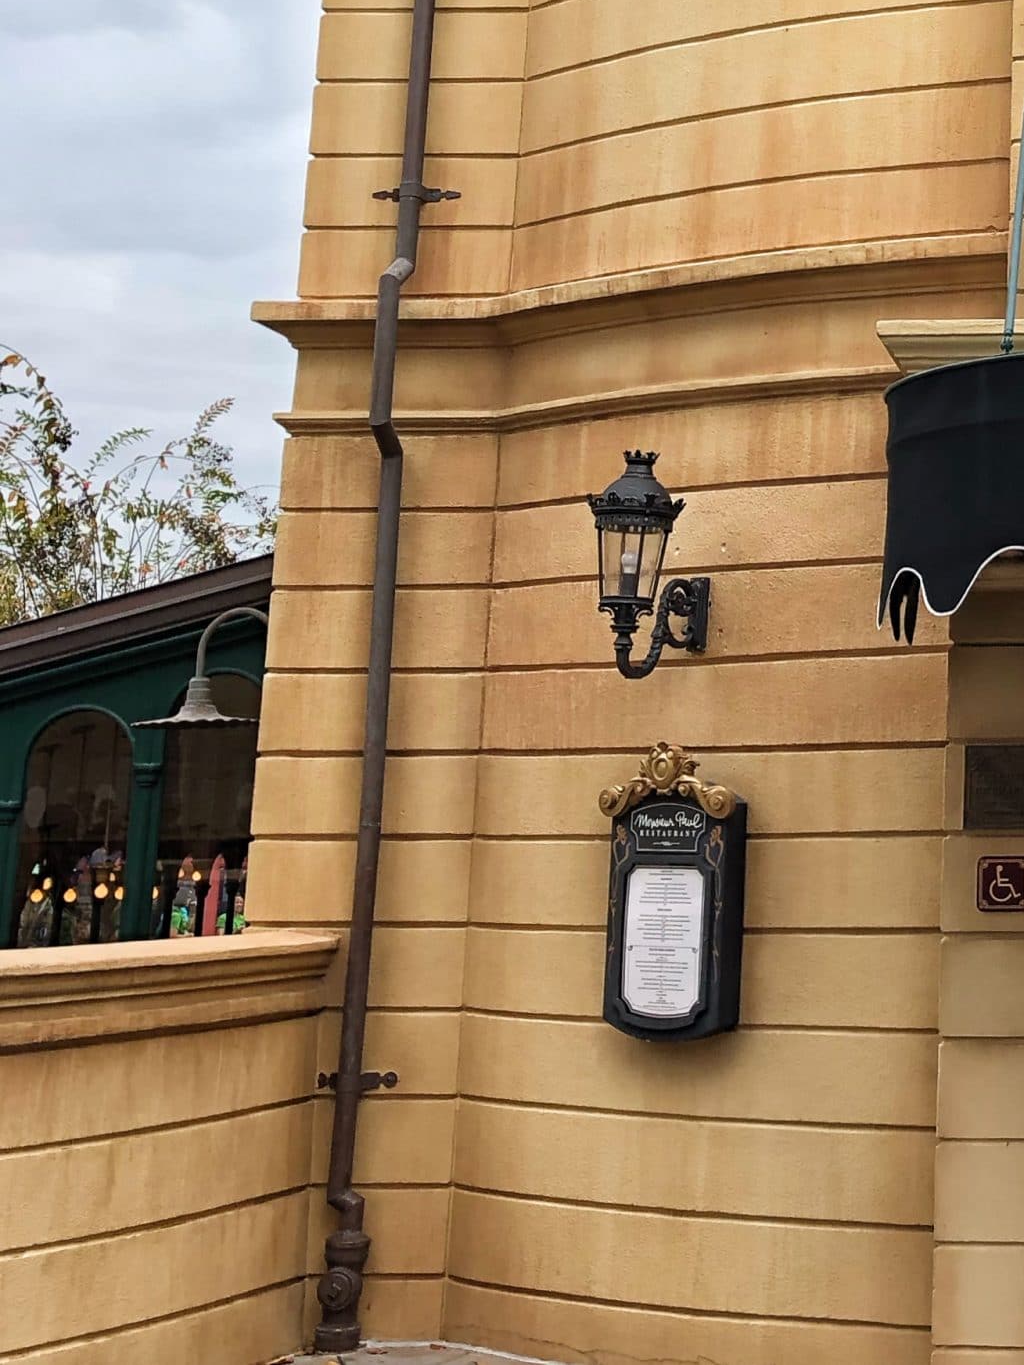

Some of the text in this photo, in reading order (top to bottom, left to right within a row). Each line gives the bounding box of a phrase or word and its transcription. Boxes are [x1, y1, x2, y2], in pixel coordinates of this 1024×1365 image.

[634, 811, 702, 829] Monsieur Paul
[639, 829, 697, 838] RESTAURANT
